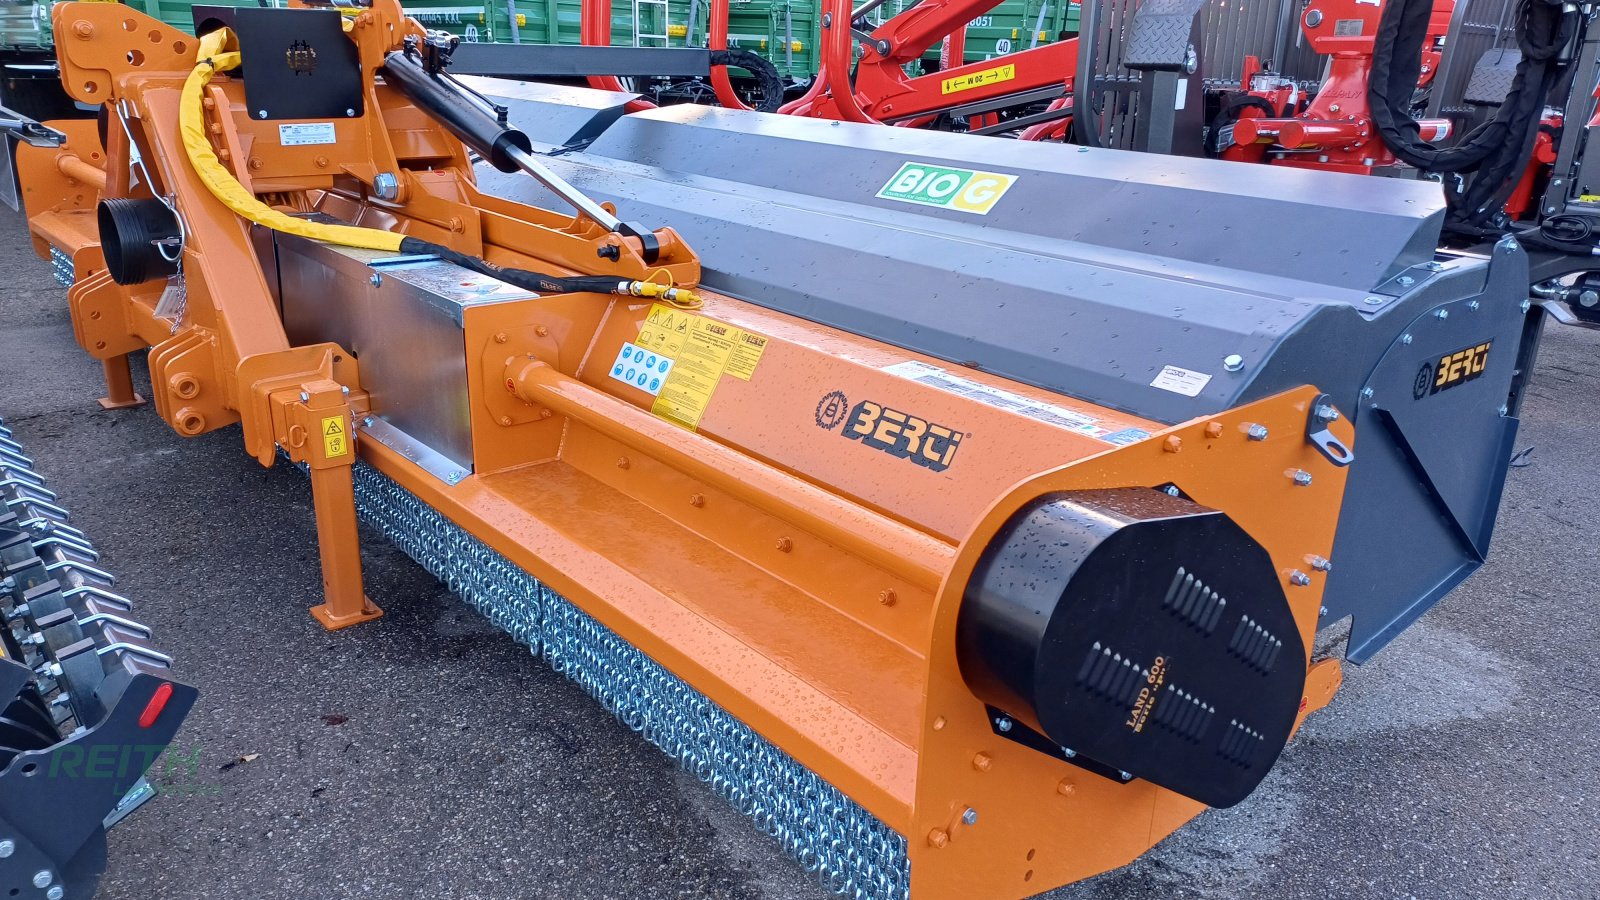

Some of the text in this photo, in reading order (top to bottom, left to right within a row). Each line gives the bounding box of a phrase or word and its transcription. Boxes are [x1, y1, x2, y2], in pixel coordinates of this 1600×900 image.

[998, 41, 1009, 53] 40
[1125, 656, 1165, 727] LAND 600
